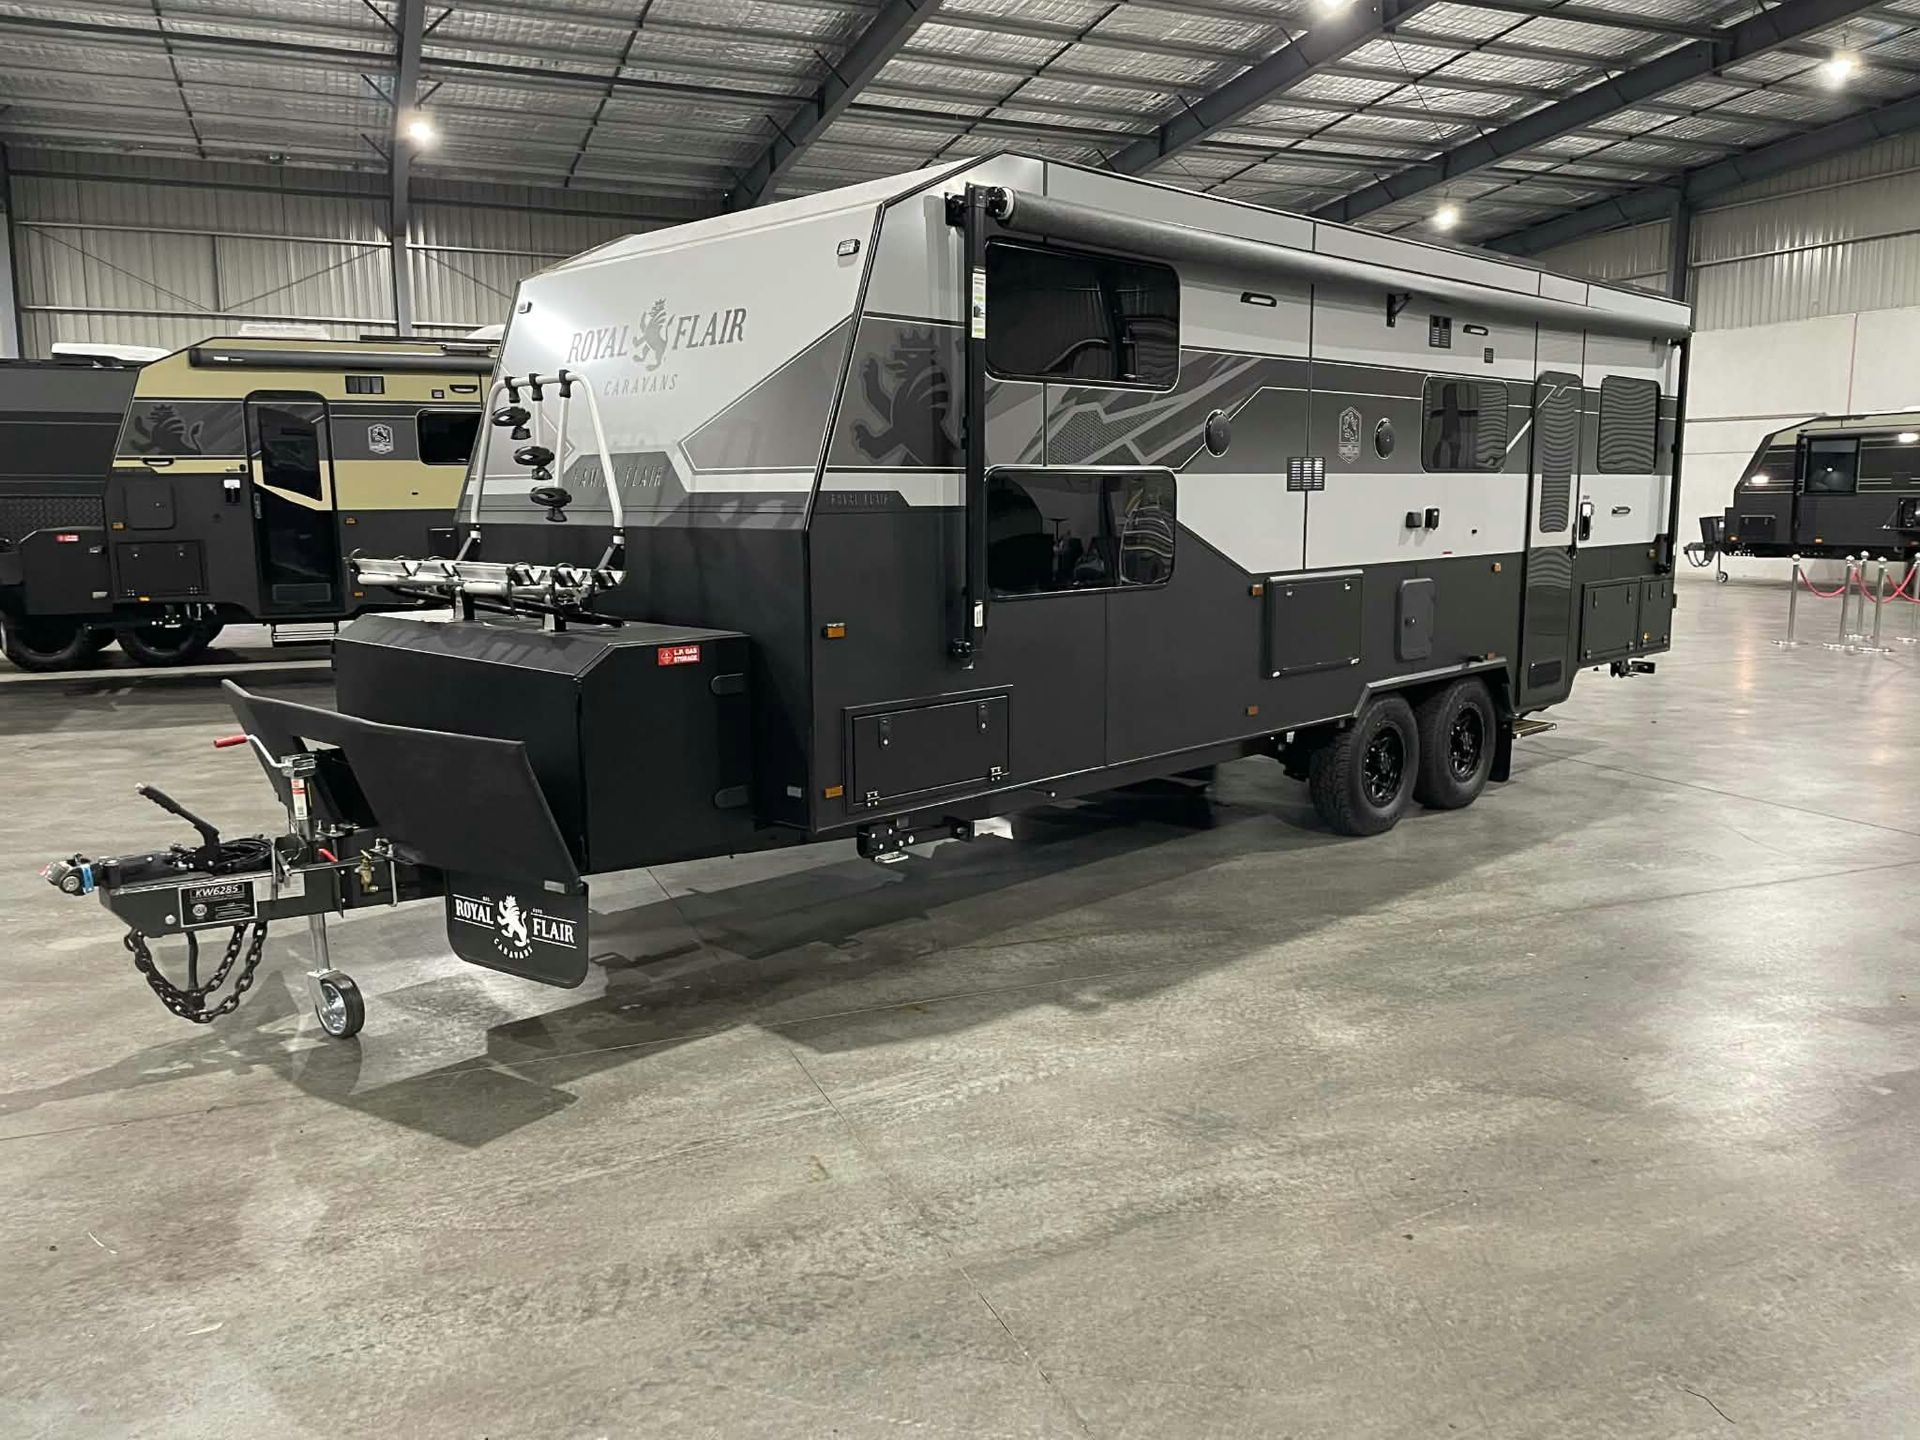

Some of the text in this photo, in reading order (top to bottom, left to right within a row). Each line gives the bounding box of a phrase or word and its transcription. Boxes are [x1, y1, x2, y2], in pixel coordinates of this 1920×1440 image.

[566, 307, 747, 364] ROYAL FLAIR
[603, 373, 679, 396] CARAVANS
[195, 883, 239, 898] KW6285
[455, 898, 575, 944] ROYAL FLAIR
[493, 938, 533, 959] CARAVANS
